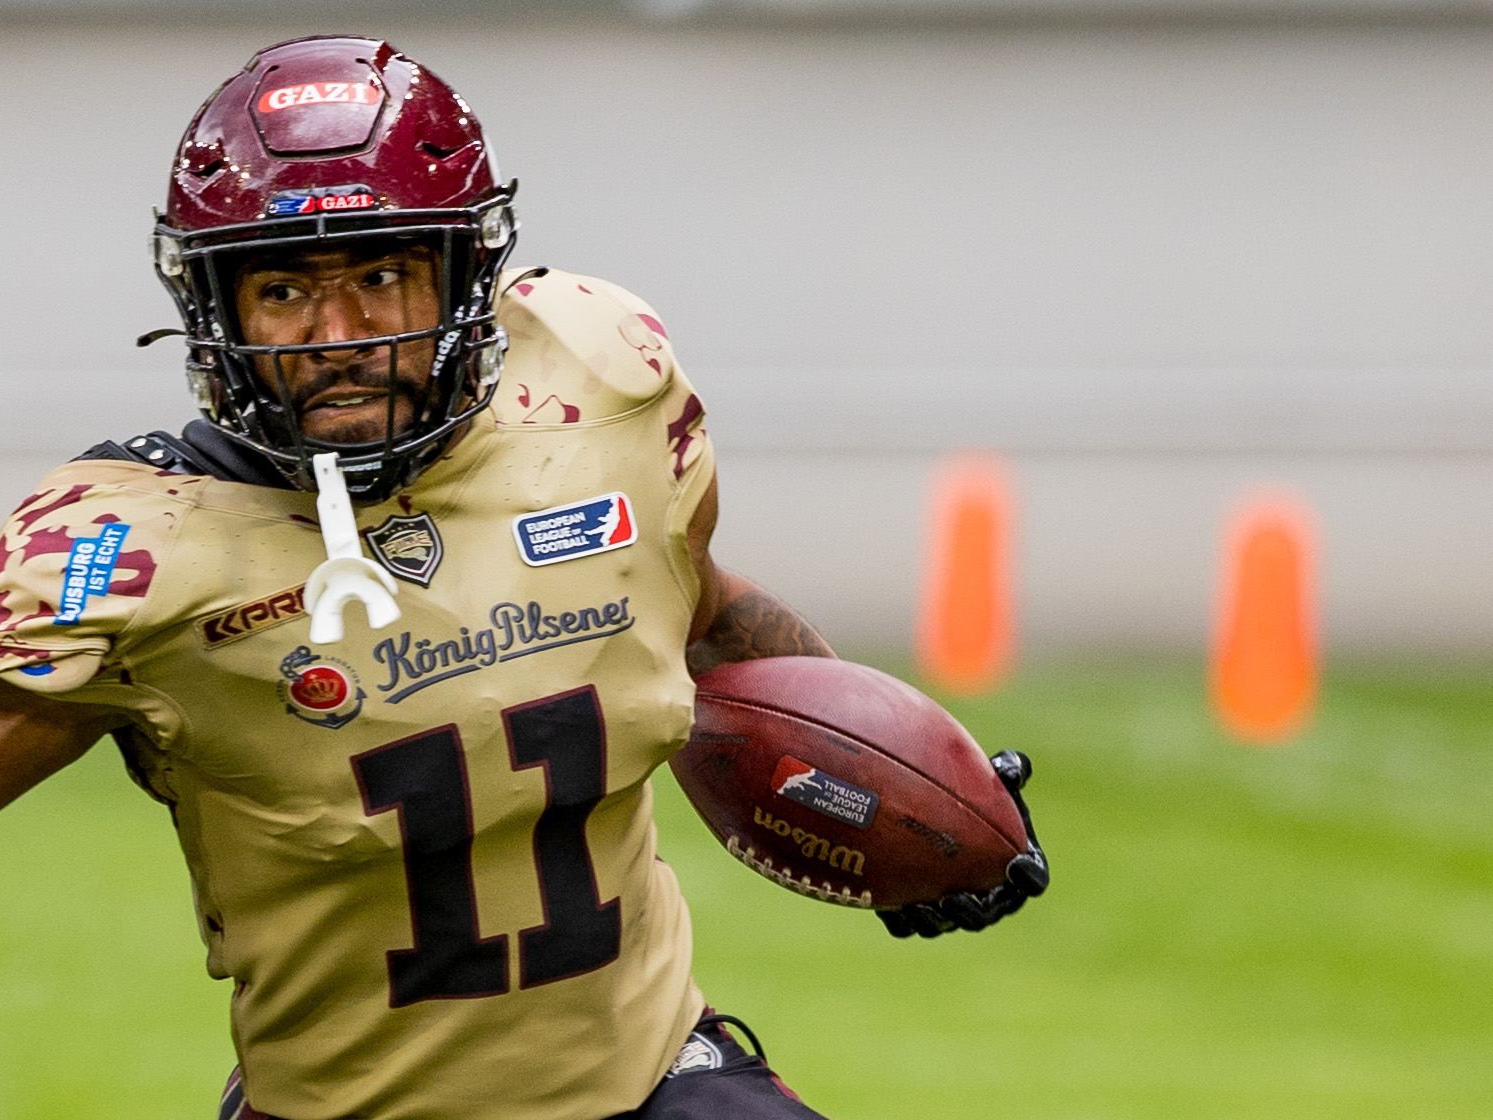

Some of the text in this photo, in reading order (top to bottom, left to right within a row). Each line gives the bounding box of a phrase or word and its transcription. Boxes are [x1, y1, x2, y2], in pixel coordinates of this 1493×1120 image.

[269, 82, 369, 109] GAZI
[321, 194, 368, 210] GAZI
[525, 511, 587, 534] EUROPEAN
[529, 526, 571, 545] LEAGUE
[532, 535, 590, 555] FOOTBALL
[87, 528, 123, 591] IST ECHT
[373, 597, 635, 692] König Pilsener
[823, 779, 872, 805] FOOTBALL
[832, 795, 868, 814] LEAGUE
[813, 797, 865, 824] EUROPEAN
[349, 683, 622, 1009] 11
